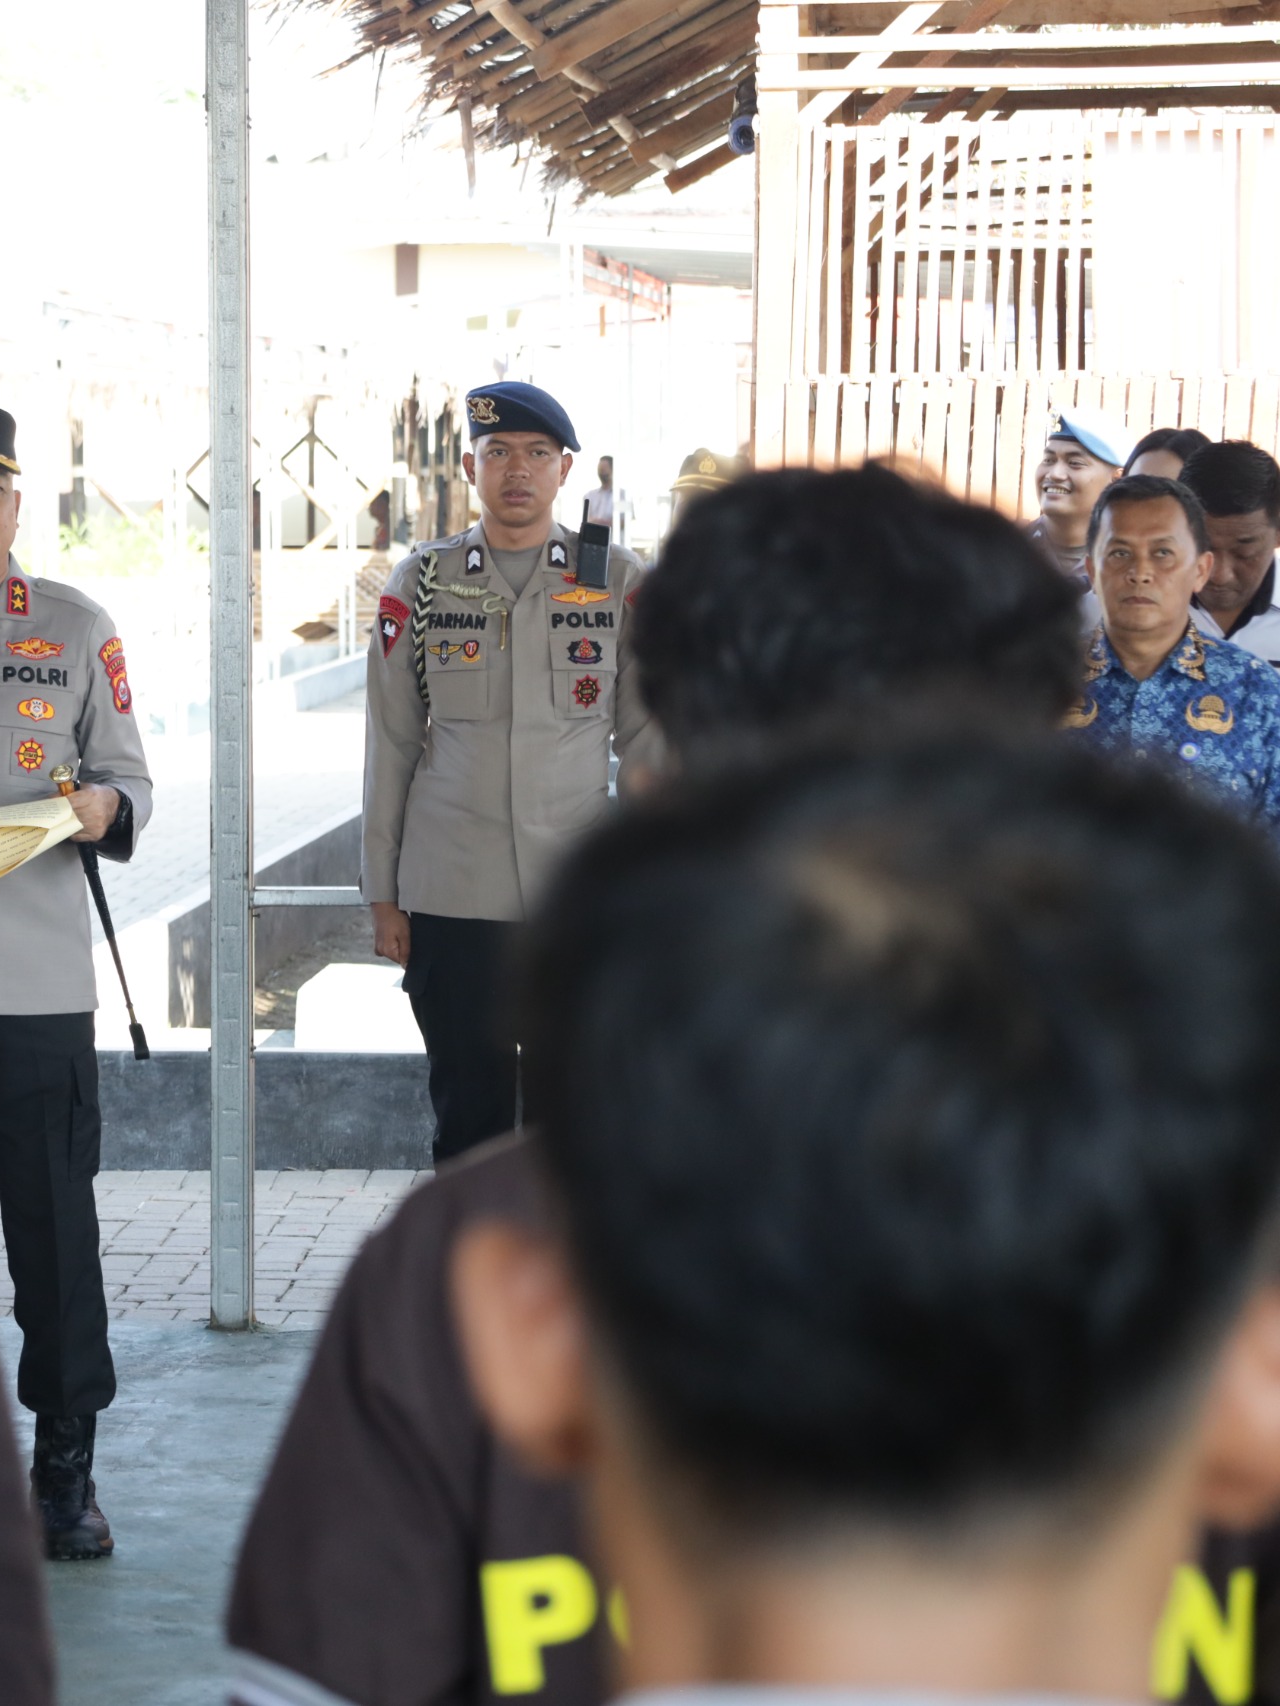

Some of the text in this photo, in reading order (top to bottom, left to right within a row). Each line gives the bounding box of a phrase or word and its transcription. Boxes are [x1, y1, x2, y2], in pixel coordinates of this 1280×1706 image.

[428, 612, 487, 630] FARHAN
[551, 611, 614, 629] POLRI
[102, 639, 123, 662] POLDA
[2, 666, 68, 687] POLRI
